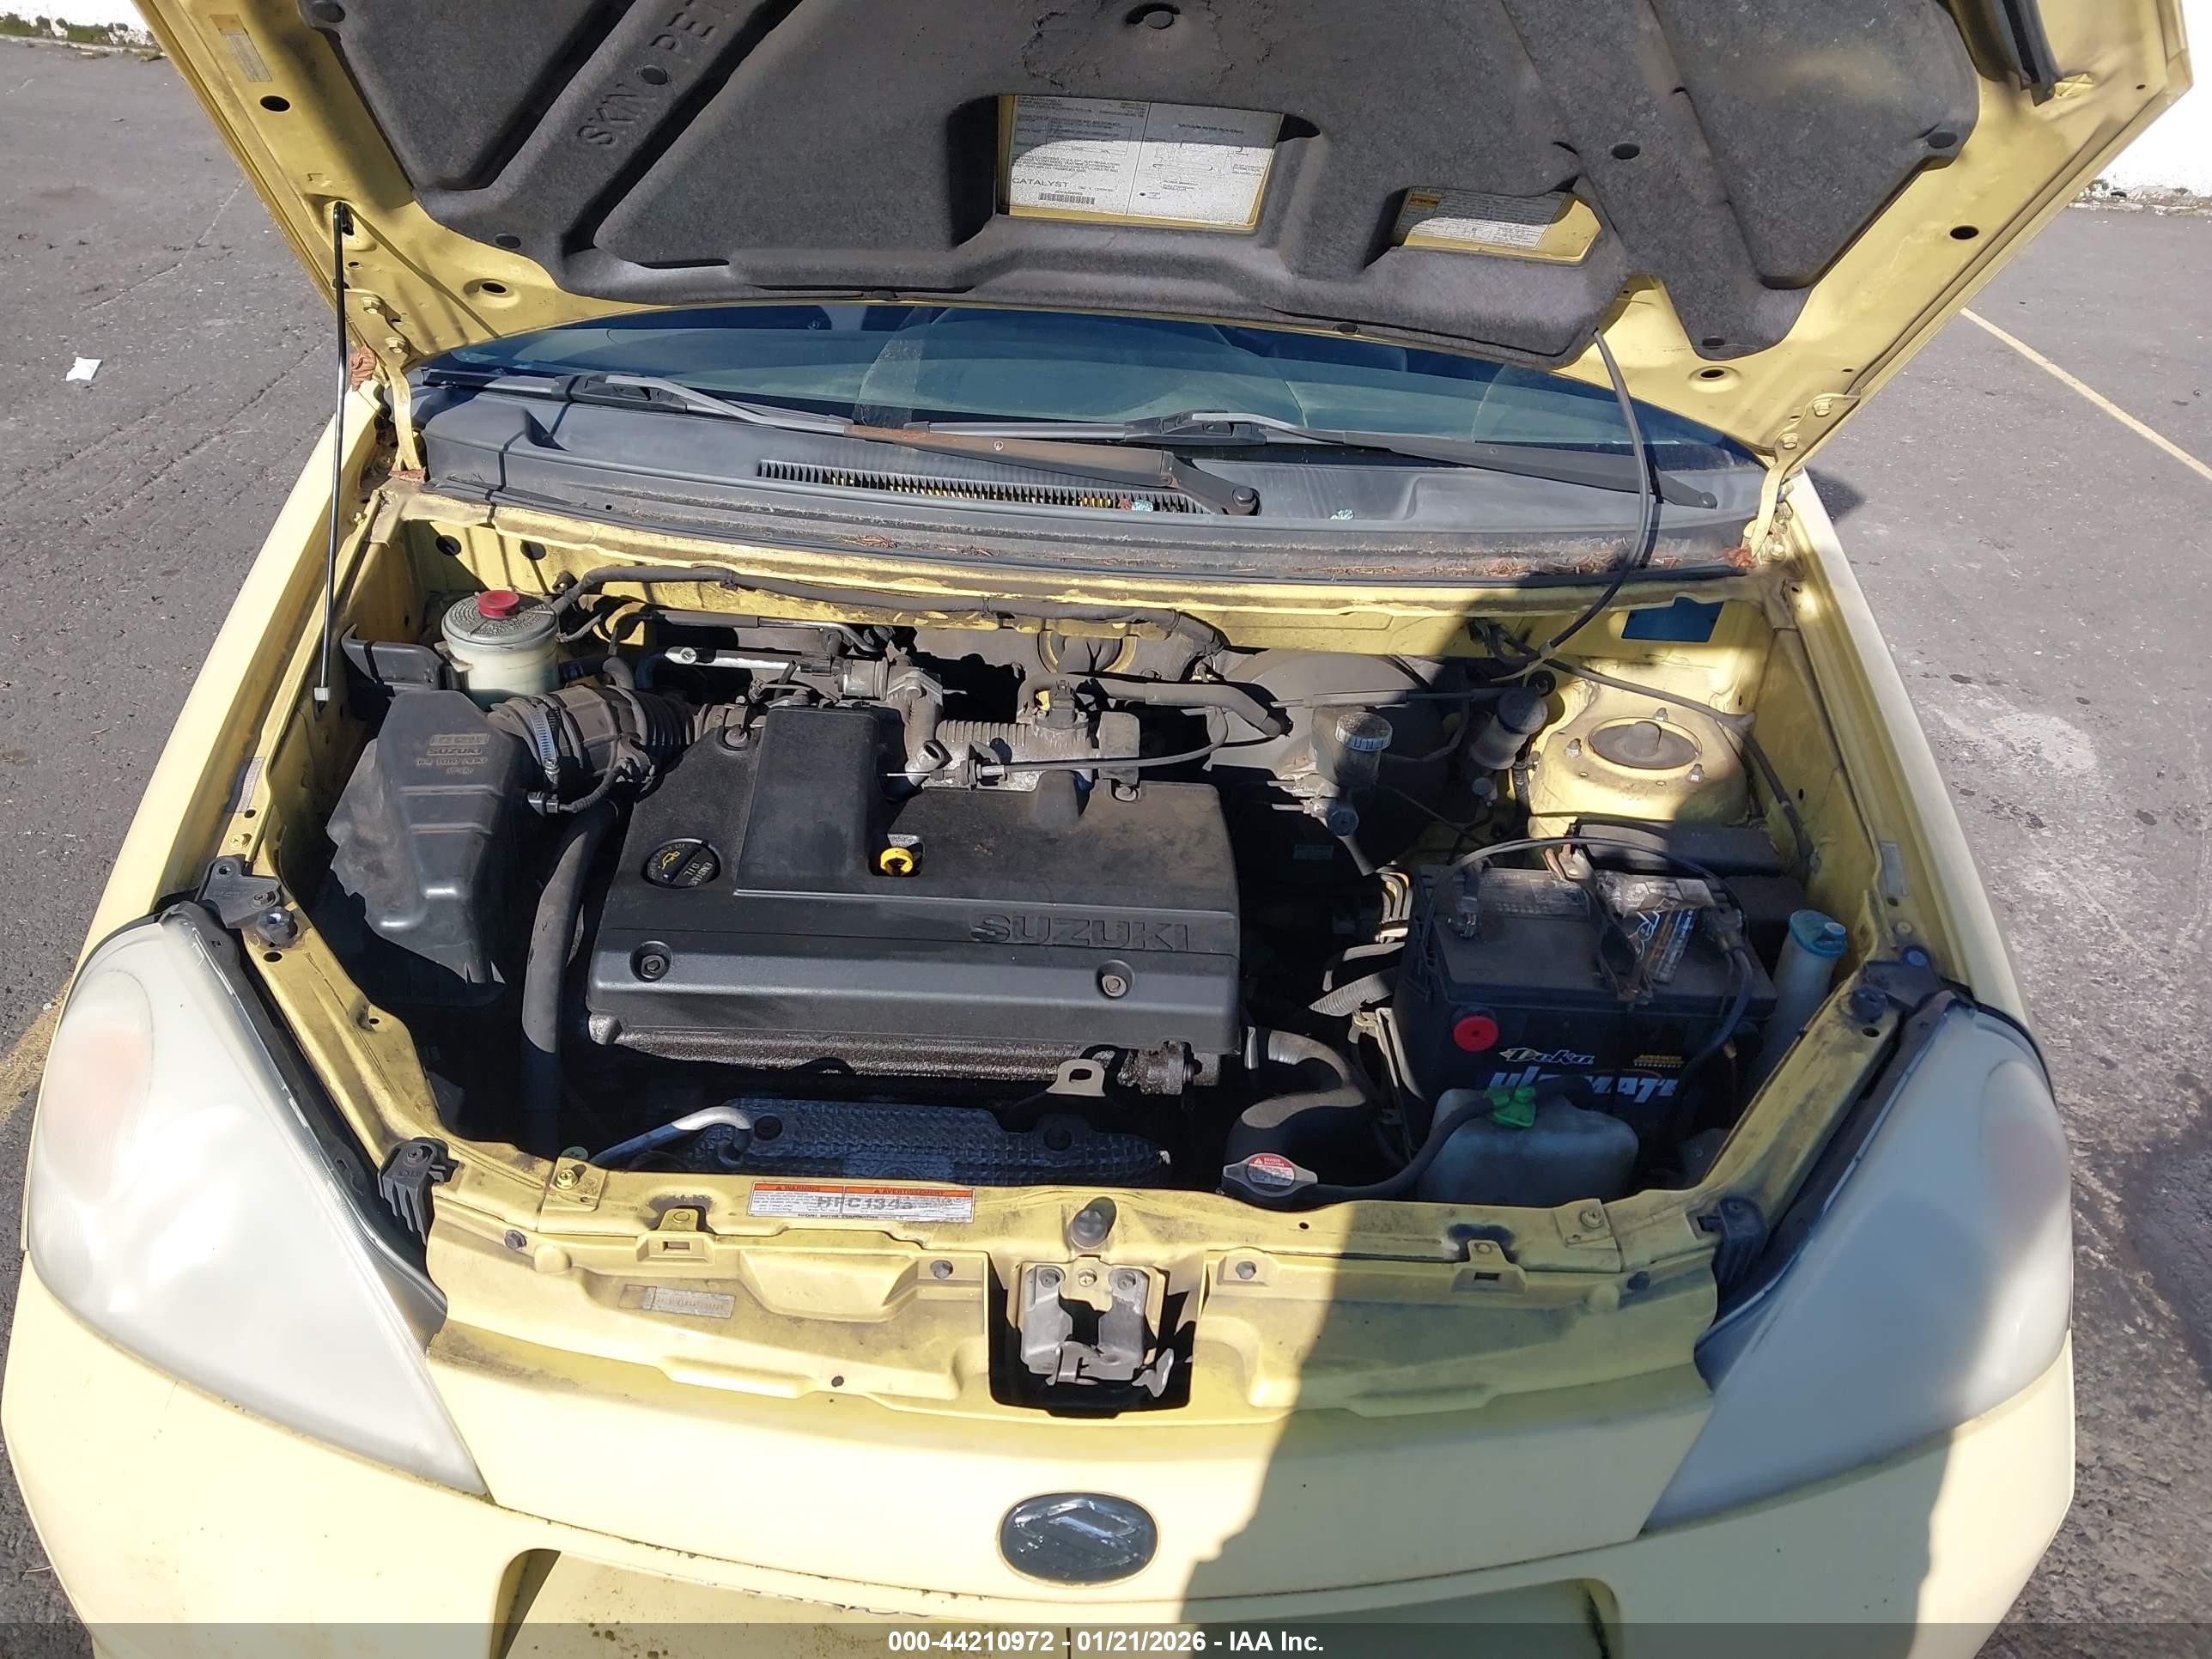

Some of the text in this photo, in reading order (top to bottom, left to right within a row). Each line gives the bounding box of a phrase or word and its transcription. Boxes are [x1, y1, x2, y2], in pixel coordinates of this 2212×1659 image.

[1012, 177, 1070, 188] CATALYST
[682, 862, 700, 877] OIL
[686, 860, 714, 886] ENGINE
[969, 914, 1189, 951] SUZUKI
[882, 1188, 944, 1196] AVERTISSEMENT
